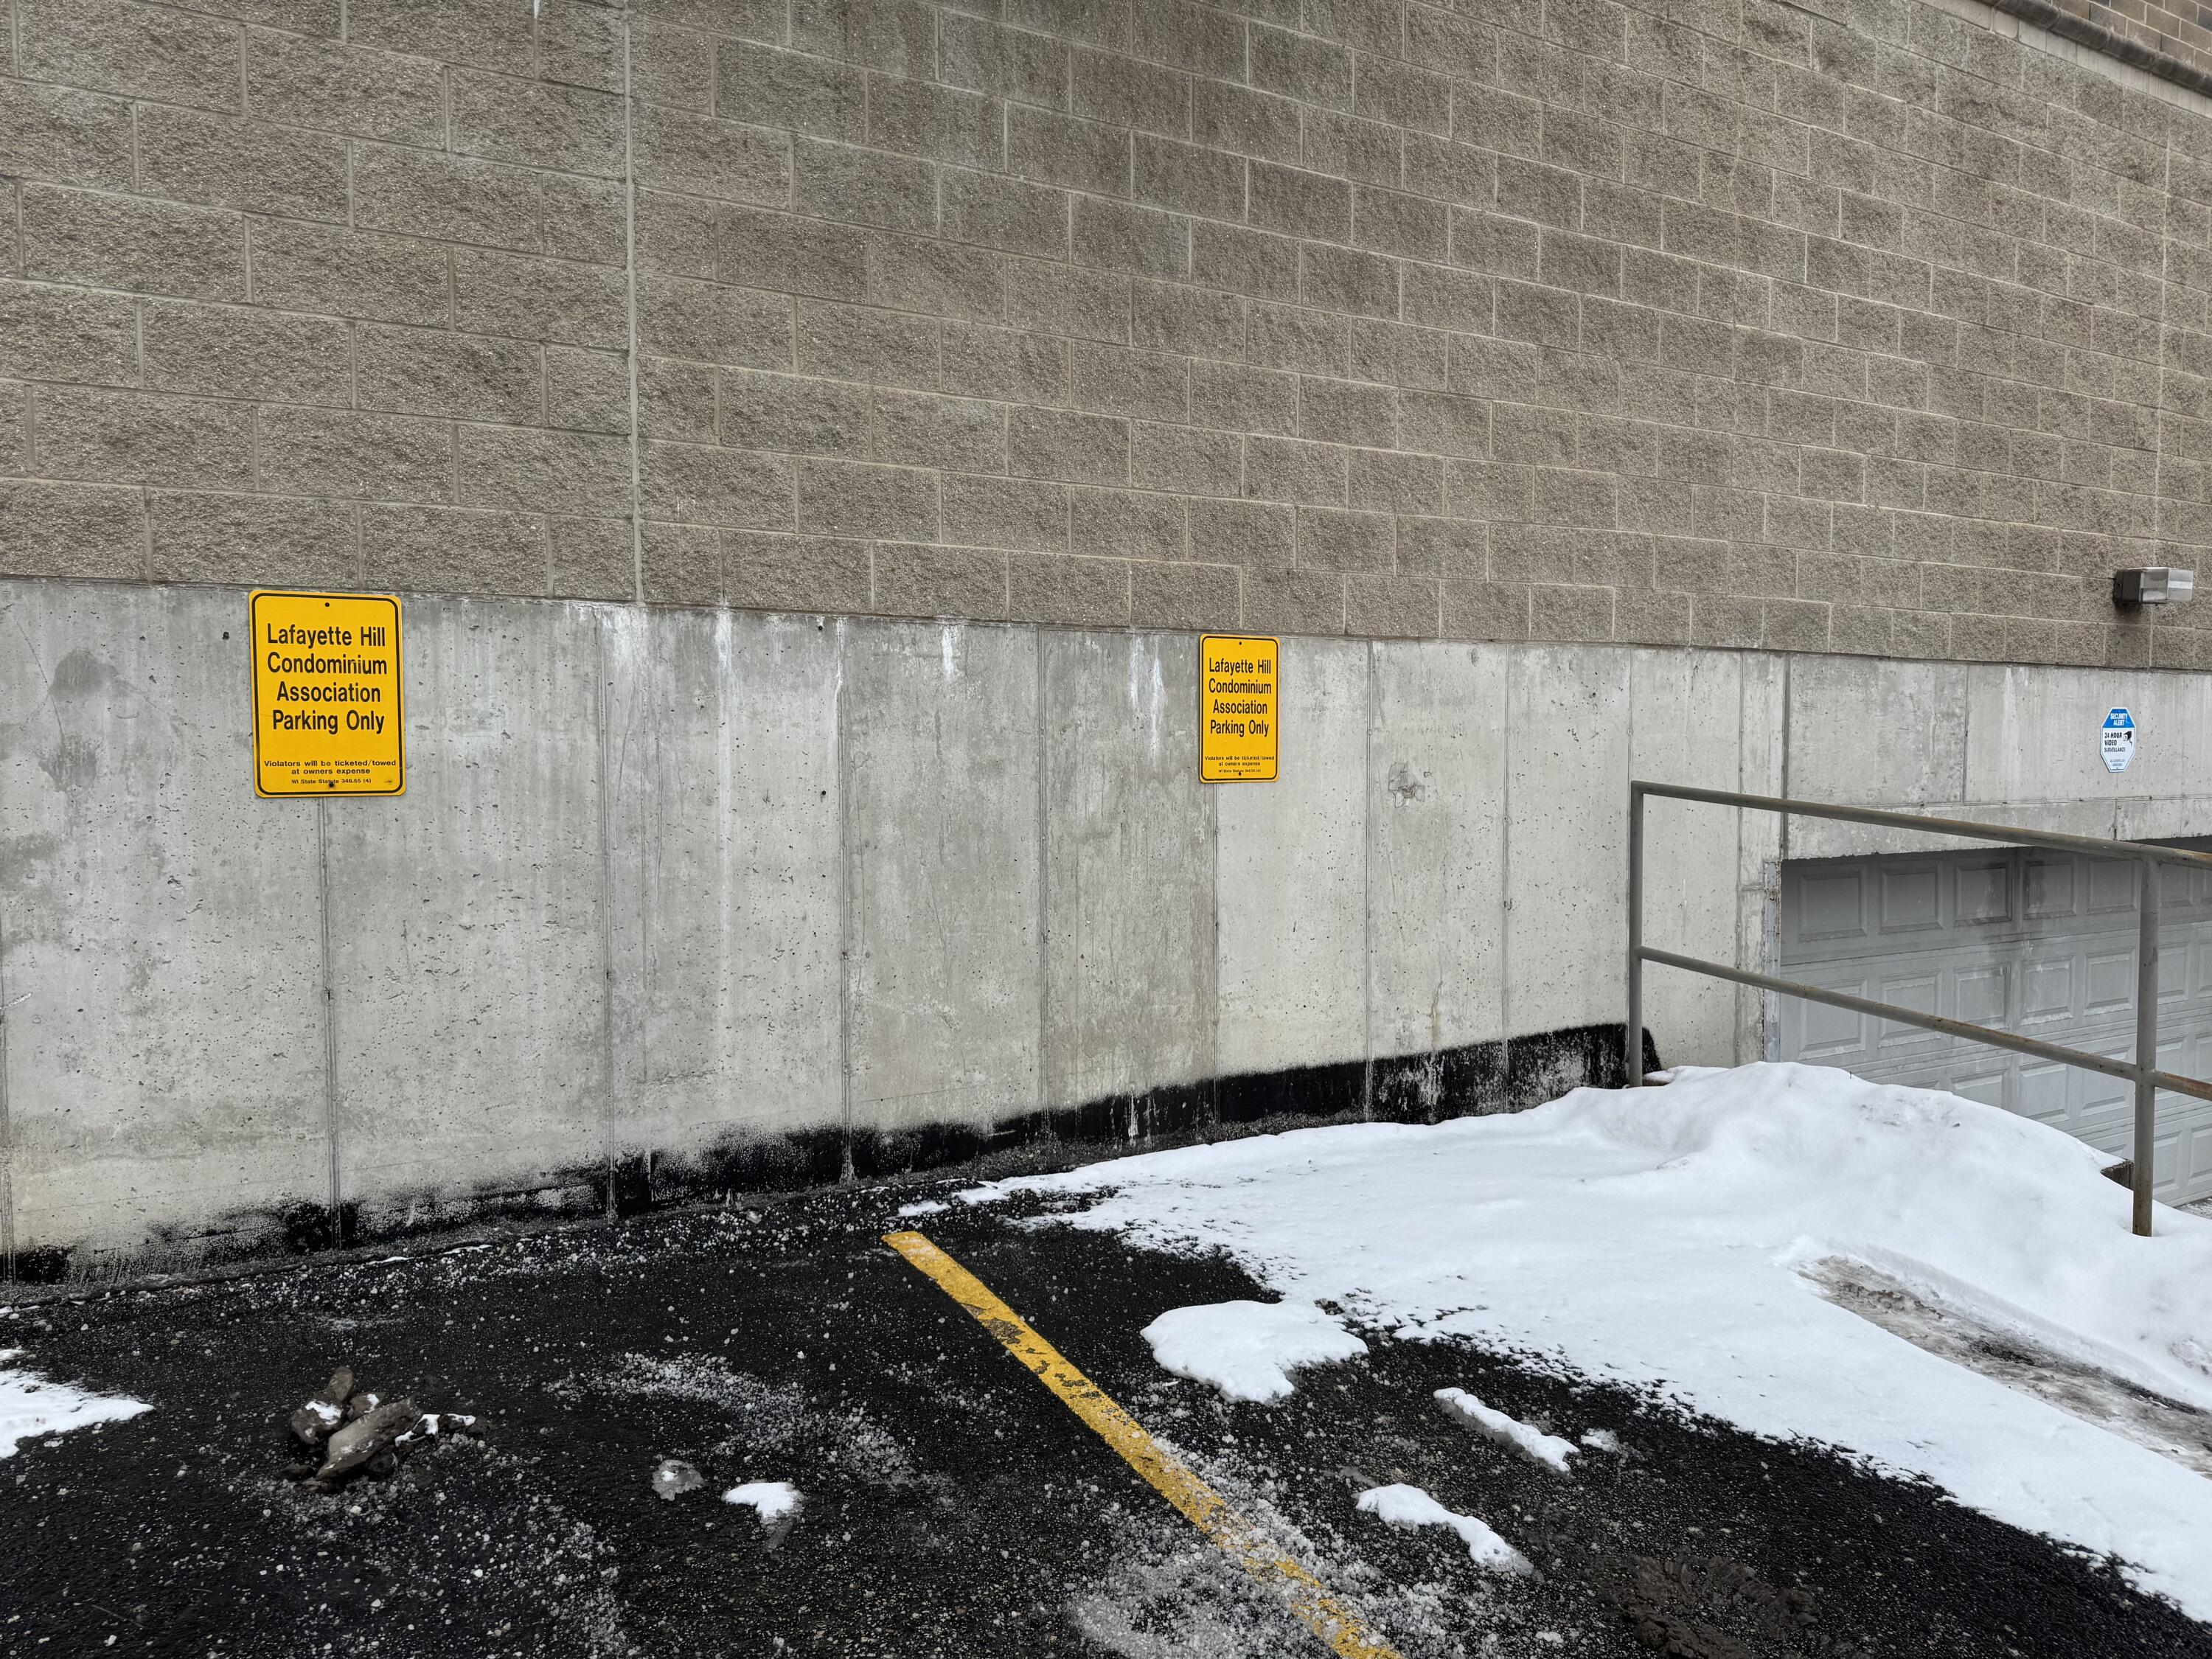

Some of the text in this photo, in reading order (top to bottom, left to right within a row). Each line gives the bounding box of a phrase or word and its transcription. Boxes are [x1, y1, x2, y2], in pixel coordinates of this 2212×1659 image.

[267, 623, 386, 649] Lafayette Hill
[267, 651, 388, 675] Condominium
[1208, 657, 1272, 676] Lafayette Hill
[276, 681, 381, 703] Association
[1208, 678, 1272, 695] Condominium
[1212, 698, 1268, 715] Association
[272, 709, 385, 735] Parking Only
[1210, 719, 1270, 737] Parking Only
